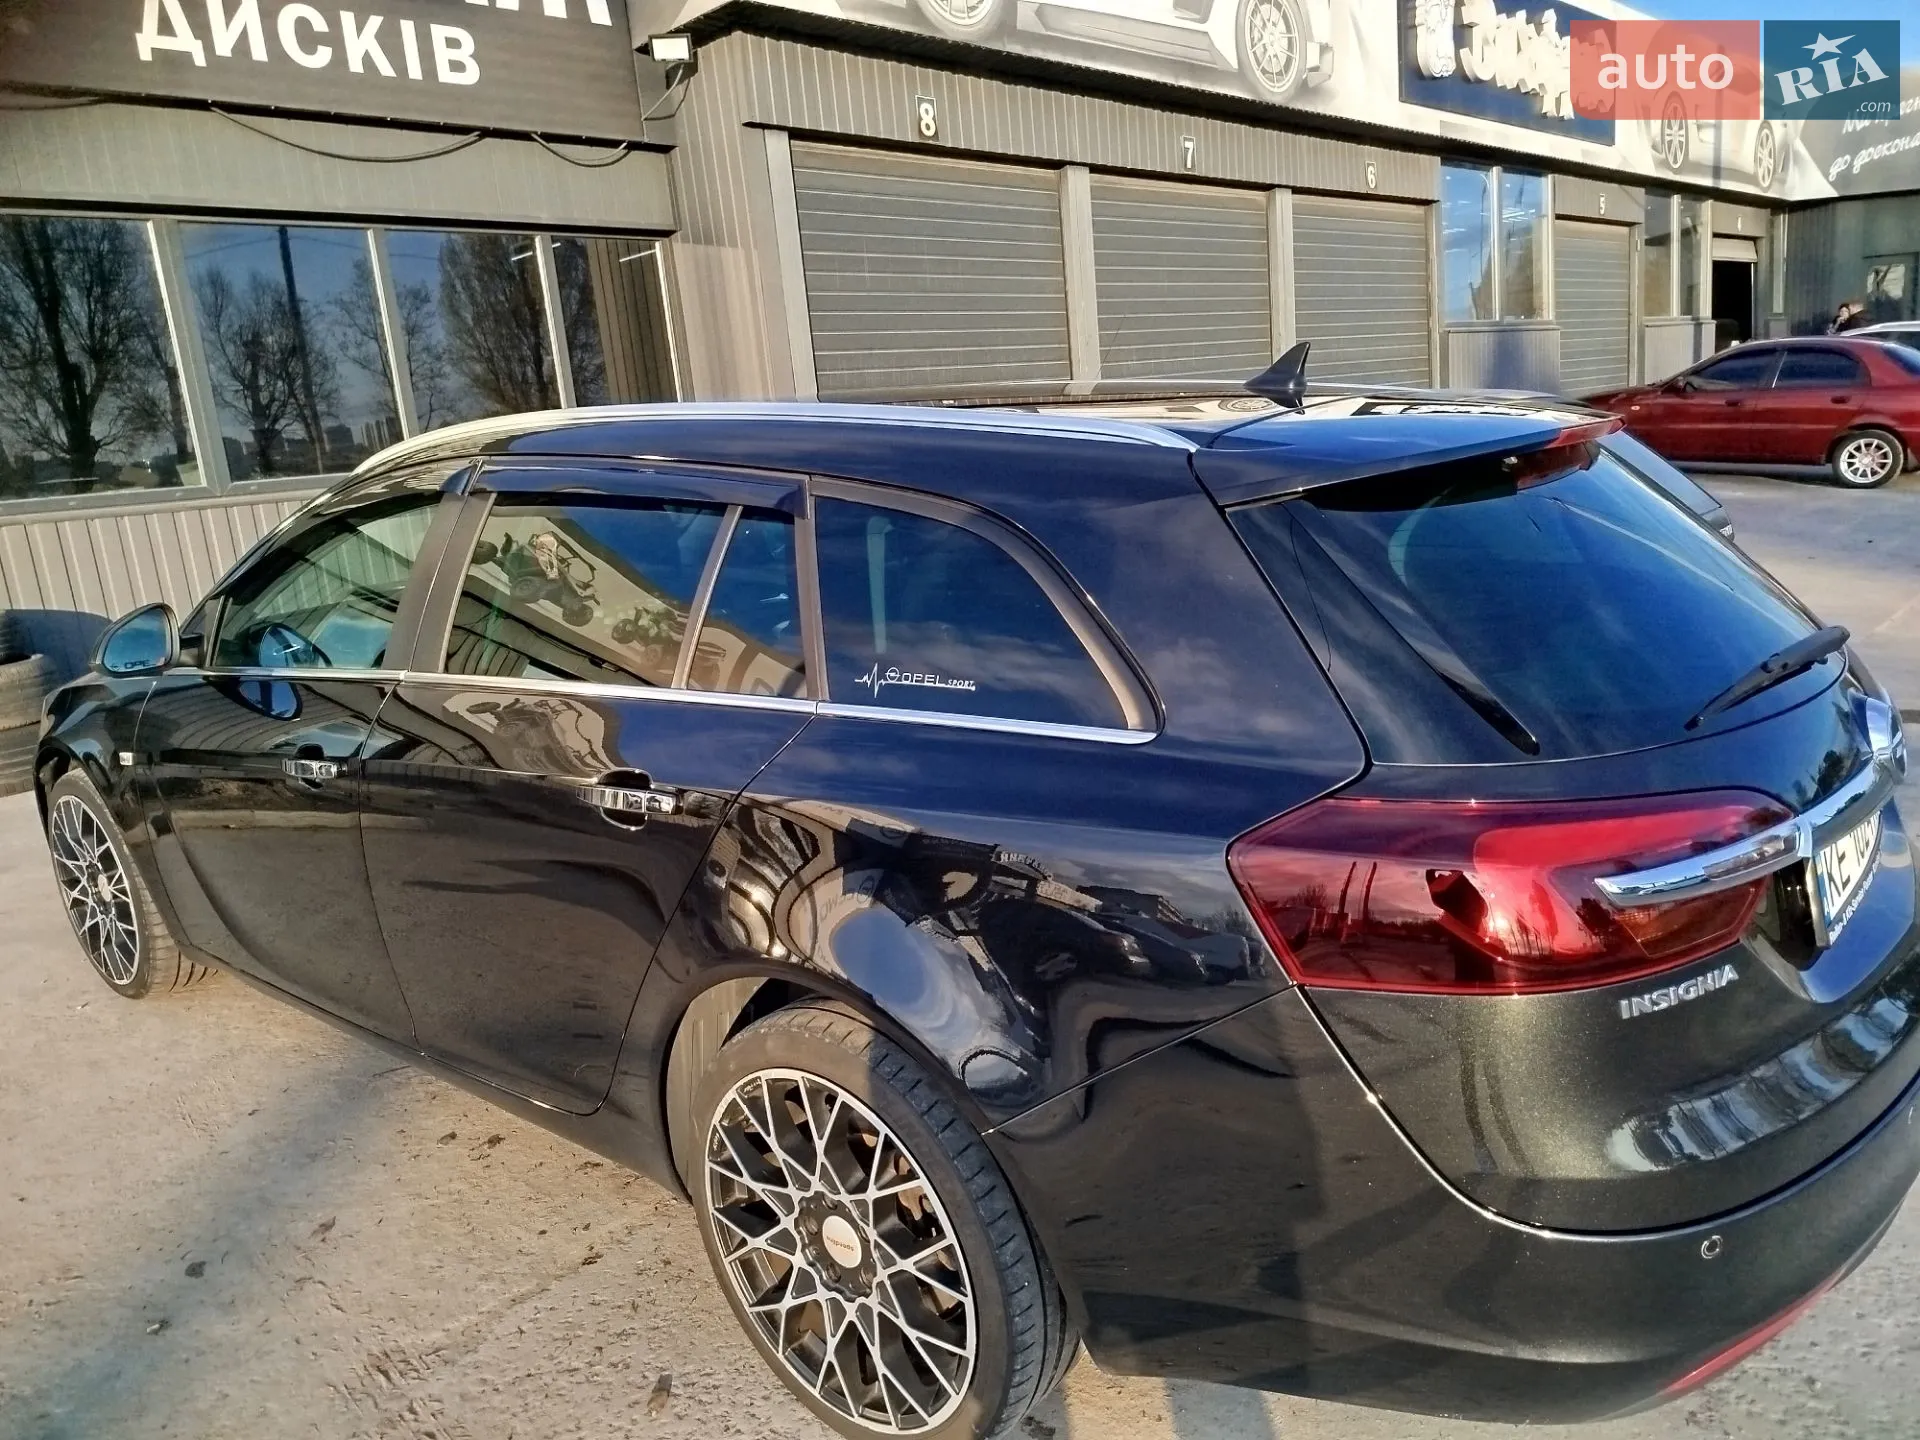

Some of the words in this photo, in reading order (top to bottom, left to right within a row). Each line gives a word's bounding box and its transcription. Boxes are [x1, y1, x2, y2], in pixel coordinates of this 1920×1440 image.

[135, 0, 481, 85] ДИСКІВ
[920, 102, 936, 137] 8
[1184, 140, 1194, 169] 7
[1367, 165, 1376, 189] 6
[901, 672, 941, 686] OPEL
[947, 678, 975, 689] SPORT
[1619, 964, 1740, 1020] INSIGNIA
